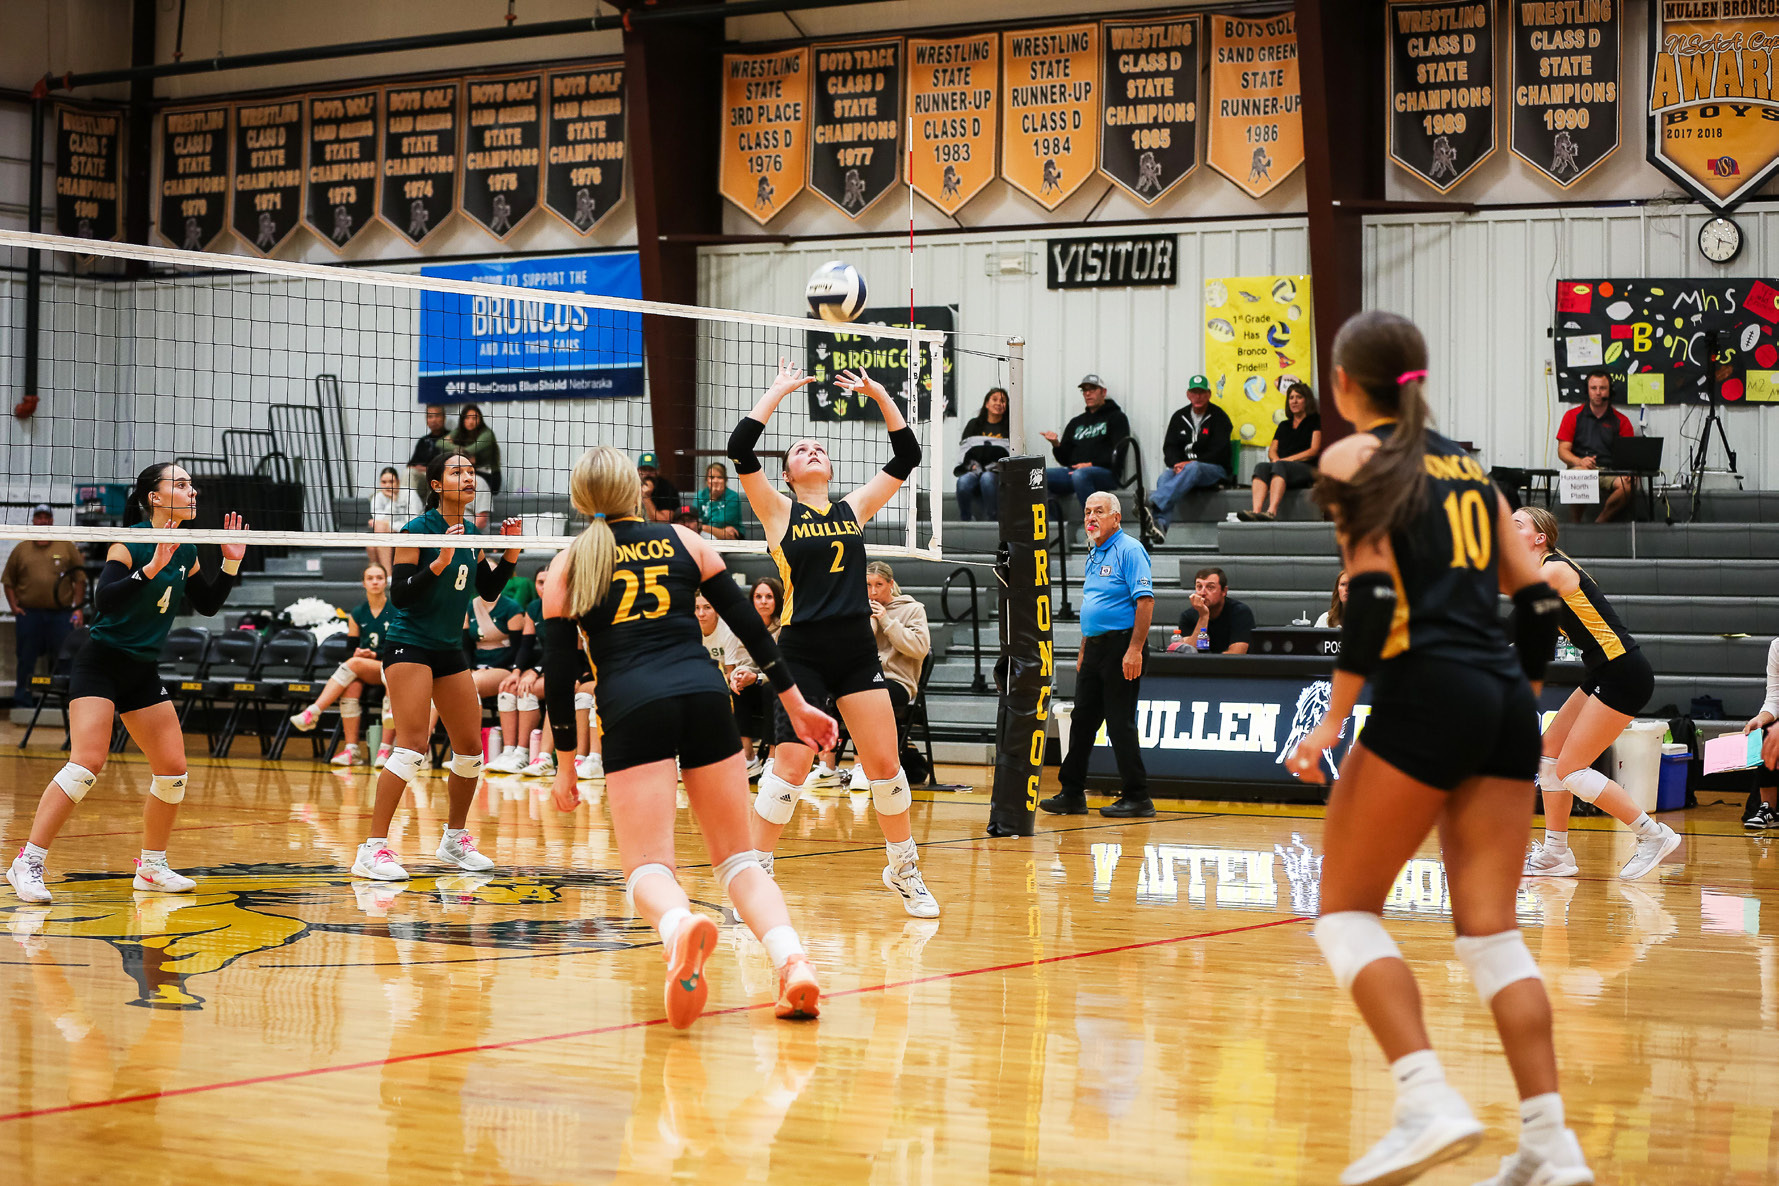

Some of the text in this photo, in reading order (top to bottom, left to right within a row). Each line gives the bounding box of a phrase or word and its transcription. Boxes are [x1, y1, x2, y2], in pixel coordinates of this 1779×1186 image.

[1398, 4, 1486, 34] WRESTLING
[1521, 0, 1612, 26] WRESTLING
[1665, 1, 1719, 19] MULLEN
[1111, 23, 1193, 50] WRESTLING
[1225, 17, 1297, 39] BOYS GOL
[1531, 28, 1601, 51] CLASS D
[916, 41, 990, 65] WRESTLING
[1012, 31, 1090, 58] WRESTLING
[1407, 33, 1476, 58] CLASS D
[1747, 31, 1779, 55] Cup
[819, 47, 895, 72] BOYS TRACK
[1119, 51, 1182, 74] CLASS D
[1218, 47, 1255, 63] SAND
[1540, 55, 1592, 78] STATE
[730, 55, 801, 79] WRESTLING
[932, 67, 972, 88] STATE
[1030, 58, 1071, 80] STATE
[1417, 61, 1468, 84] STATE
[553, 72, 622, 98] BOYS GOLF
[745, 80, 782, 101] STATE
[827, 72, 885, 95] CLASS D
[1126, 77, 1174, 99] STATE
[1241, 69, 1284, 89] STATE
[471, 80, 538, 104] BOYS GOLF
[915, 89, 992, 114] RUNNER-UP
[1011, 82, 1093, 107] RUNNER-UP
[1395, 86, 1492, 112] CHAMPIONS
[1516, 81, 1616, 106] CHAMPIONS
[730, 102, 802, 127] 3RD PLACE
[833, 97, 878, 119] STATE
[1105, 101, 1196, 126] CHAMPIONS
[1221, 95, 1302, 117] RUNNER-UP
[1666, 105, 1779, 126] BOYS
[923, 117, 981, 141] CLASS D
[1021, 110, 1082, 134] CLASS D
[1423, 113, 1467, 136] 1989
[1543, 108, 1590, 130] 1990
[484, 127, 522, 148] STATE
[567, 120, 607, 142] STATE
[738, 129, 793, 152] CLASS D
[815, 120, 897, 144] CHAMPIONS
[1246, 124, 1278, 143] 1986
[1666, 127, 1723, 139] 2017 2018
[549, 141, 624, 165] CHAMPIONS
[836, 147, 874, 167] 1977
[933, 143, 972, 163] 1983
[1033, 136, 1072, 157] 1984
[466, 148, 539, 170] CHAMPIONS
[747, 154, 783, 174] 1976
[1052, 239, 1173, 283] VISITOR
[522, 271, 565, 287] SUPPORT
[569, 269, 588, 285] THE
[472, 291, 589, 337] BRONCOS
[1245, 314, 1271, 324] Grade
[1244, 331, 1260, 340] Has
[502, 341, 521, 356] ALL
[1237, 347, 1268, 356] Bronco
[1423, 454, 1490, 486] ONCO
[792, 520, 863, 541] MULLEN
[1443, 489, 1492, 572] 10
[614, 538, 675, 564] ONCOS
[829, 540, 845, 574] 2
[454, 564, 469, 591] 8
[157, 586, 173, 614] 4
[611, 564, 671, 626] 25
[368, 632, 380, 648] 3
[1026, 503, 1053, 812] BRONCOS
[1094, 699, 1281, 753] ULLEN
